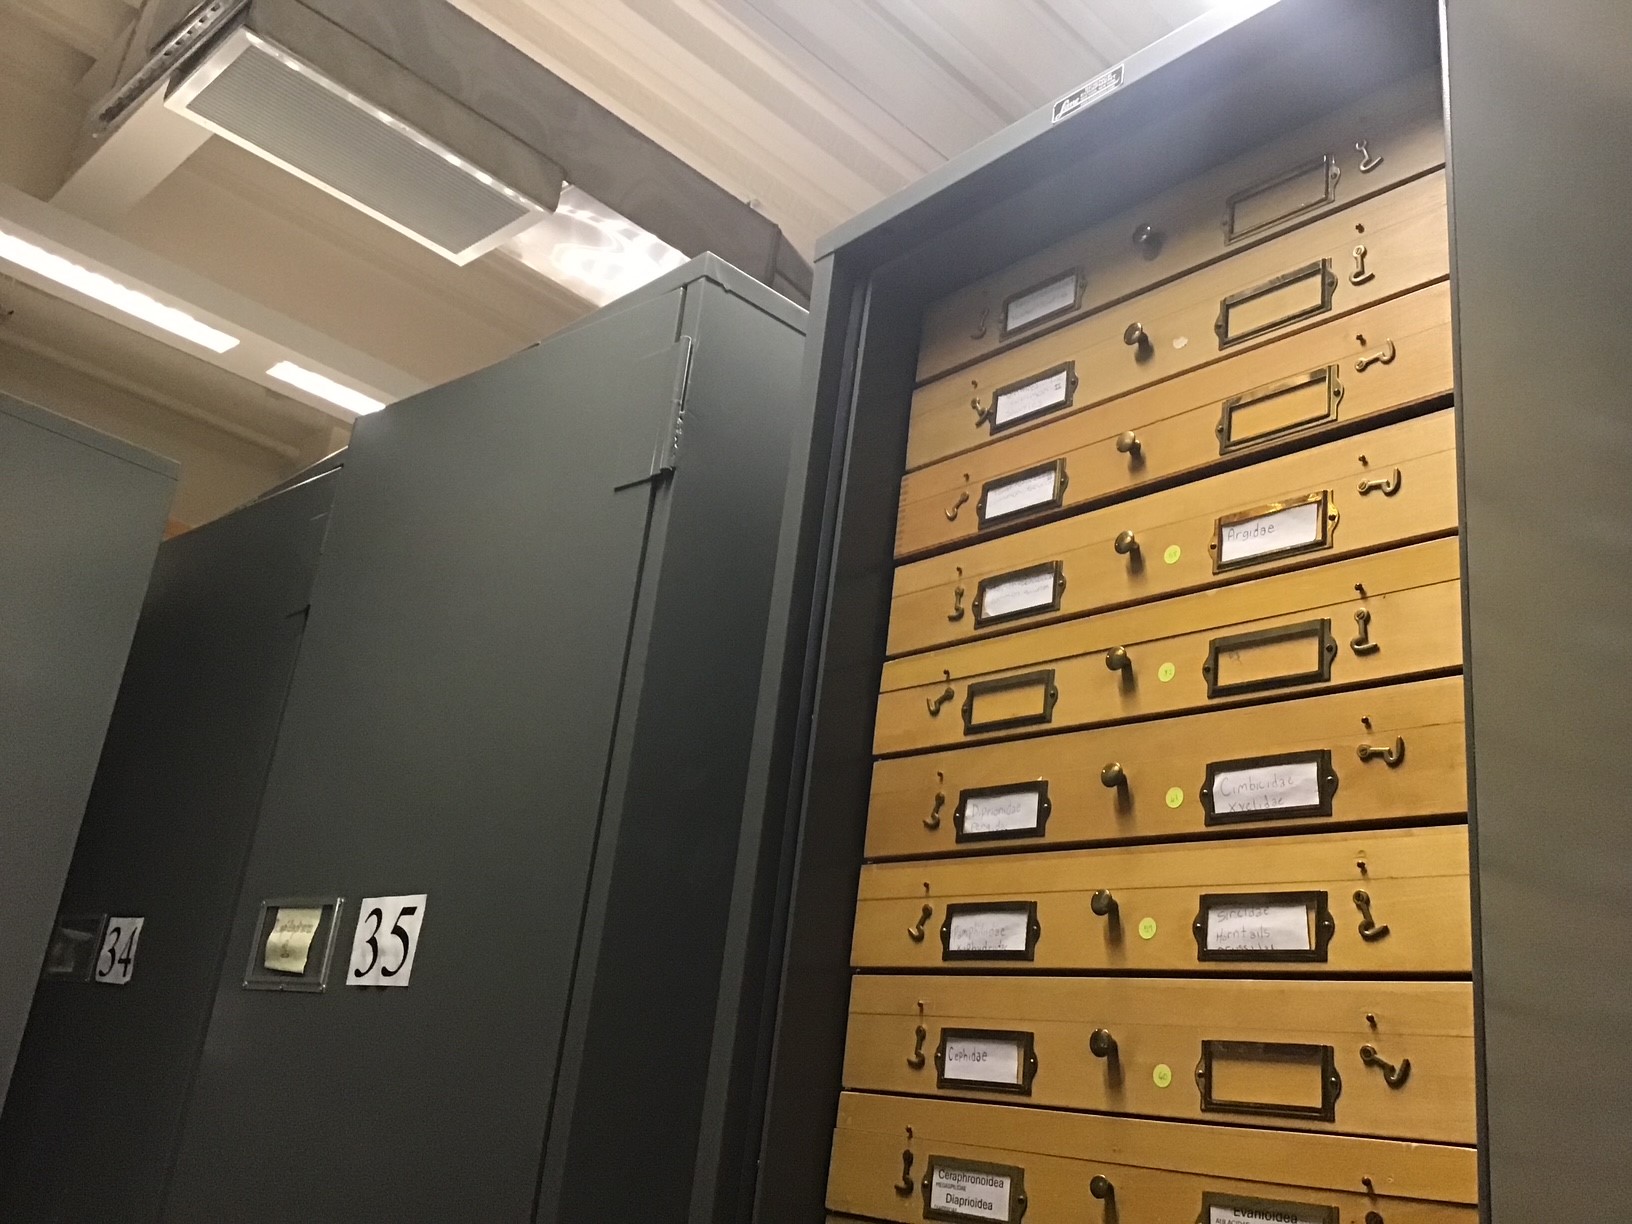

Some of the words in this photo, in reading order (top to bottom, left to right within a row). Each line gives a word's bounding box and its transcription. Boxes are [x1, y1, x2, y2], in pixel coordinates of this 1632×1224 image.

[1227, 523, 1276, 542] Argidae
[354, 906, 418, 978] 35
[1215, 922, 1271, 943] Horntails
[98, 926, 139, 977] 34
[948, 1045, 988, 1064] Cephidae
[938, 1168, 1005, 1189] Ceraphronoidea
[945, 1192, 994, 1211] Diaprioidea
